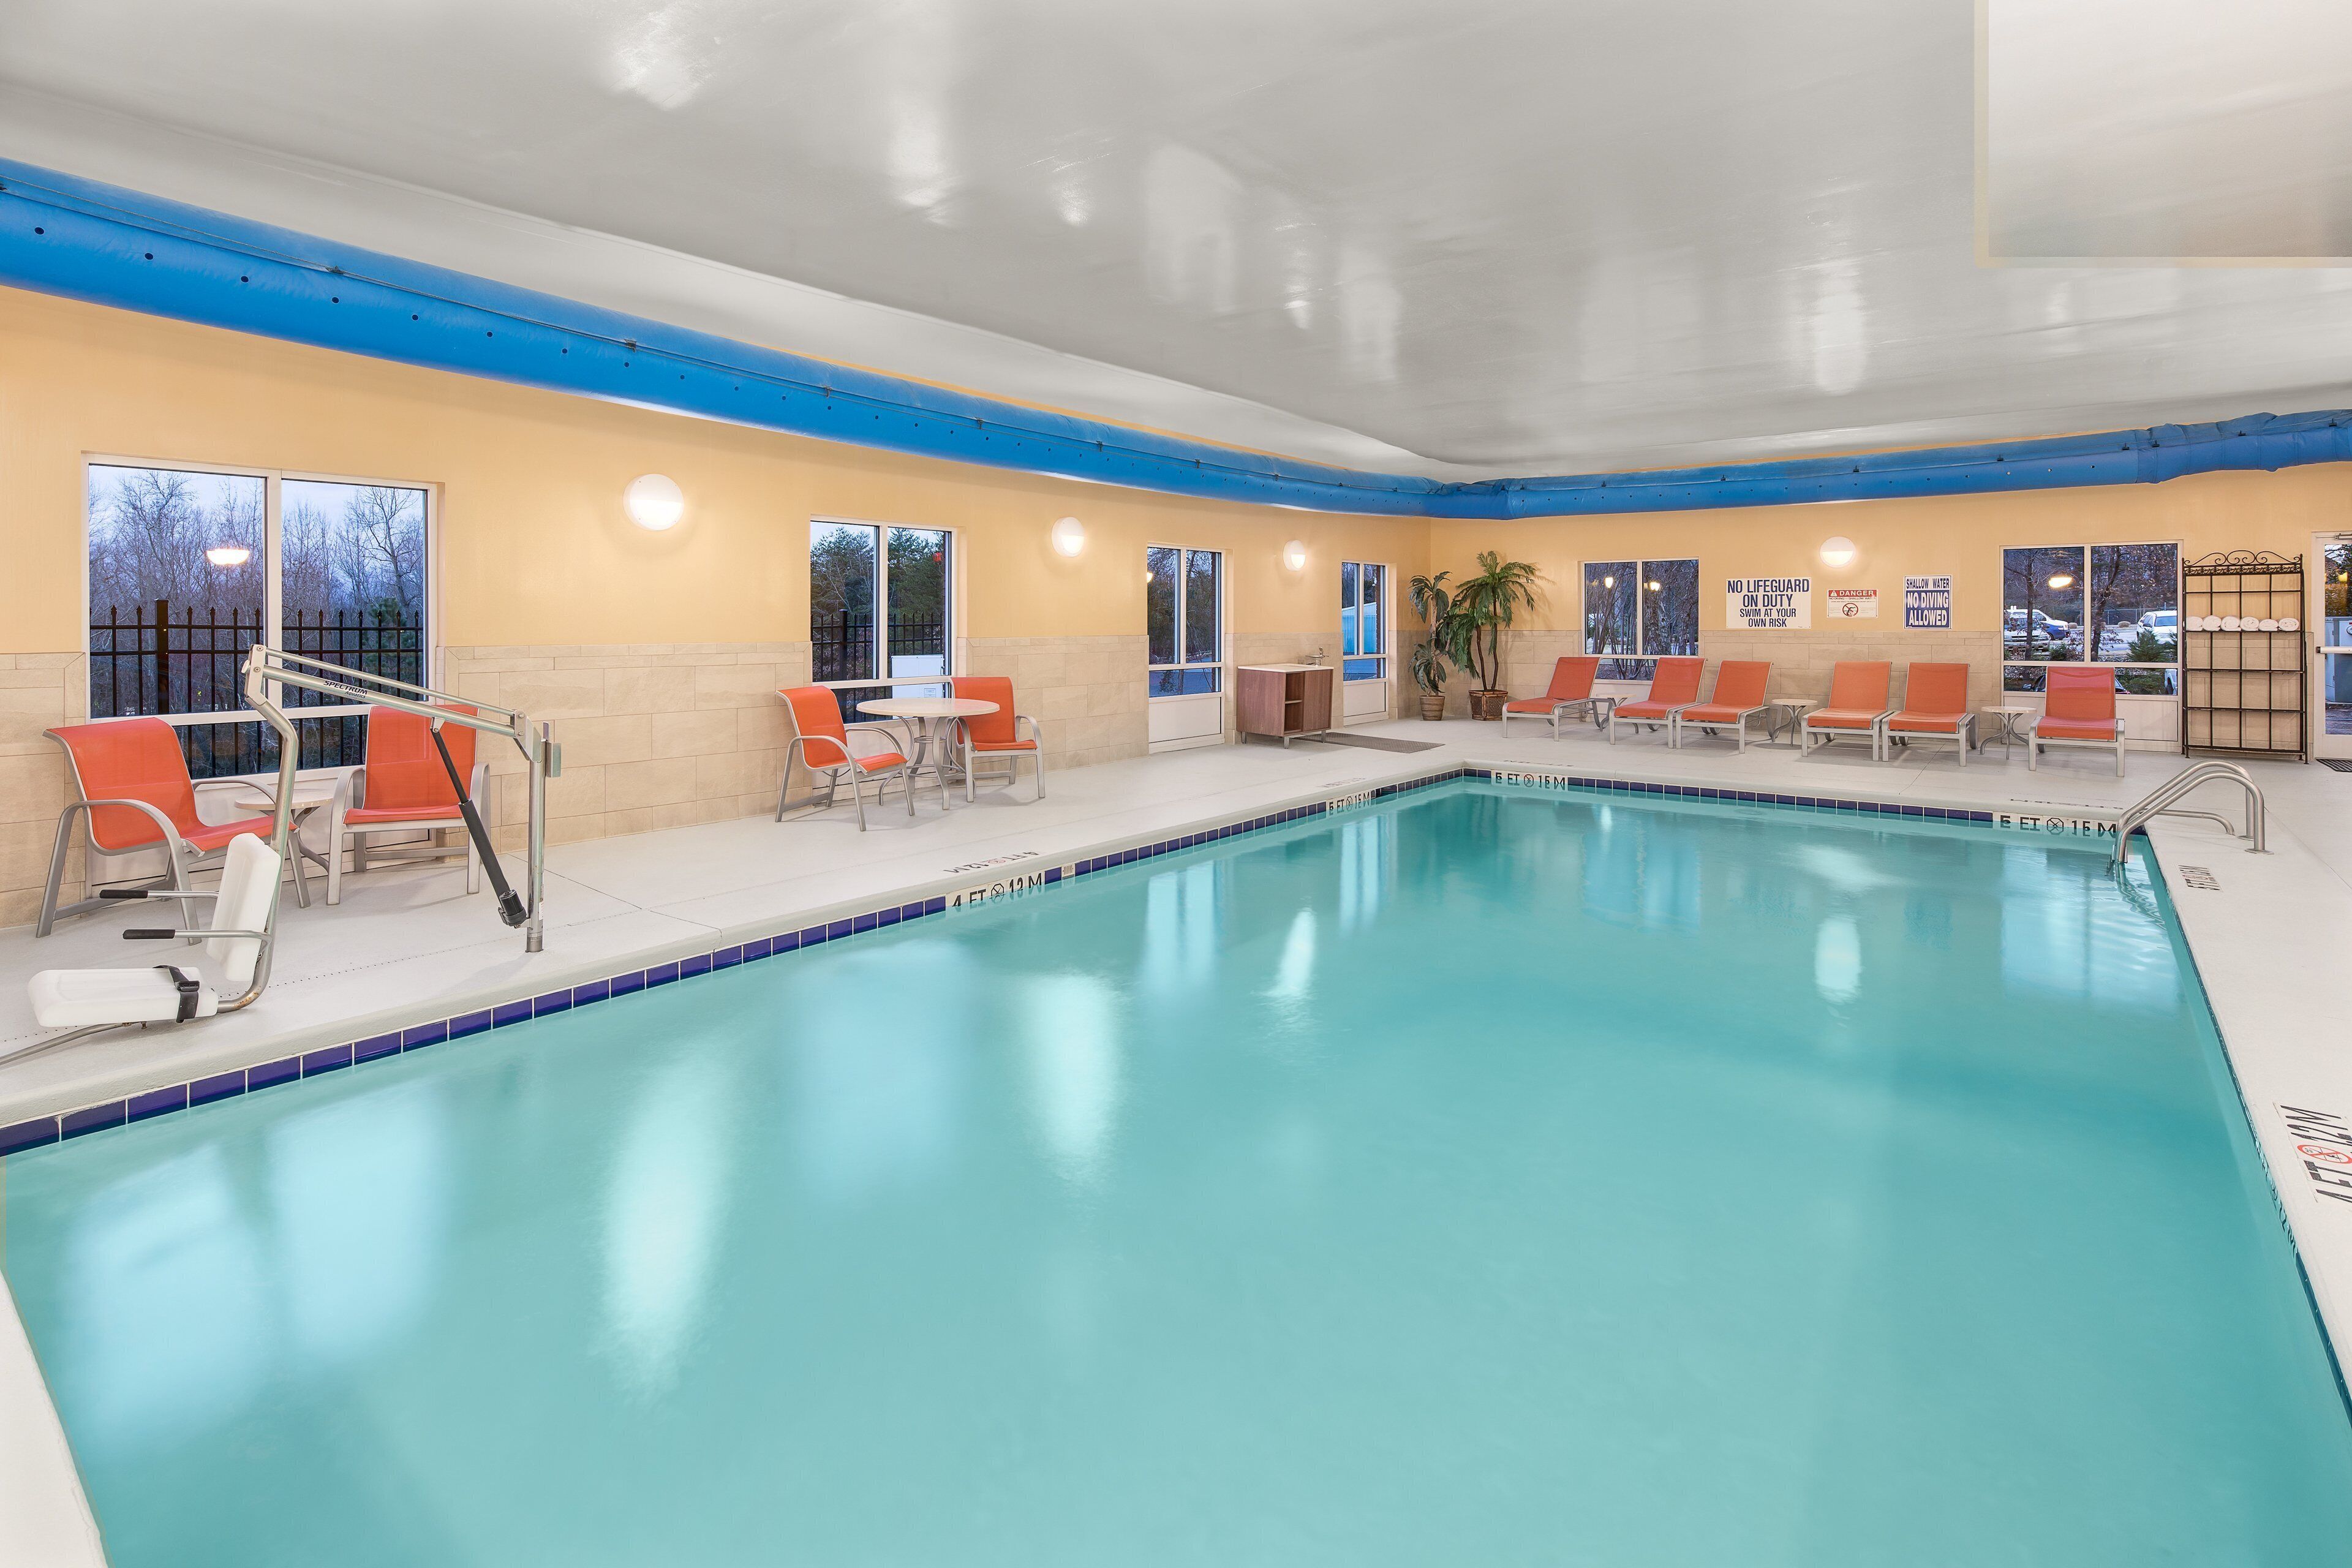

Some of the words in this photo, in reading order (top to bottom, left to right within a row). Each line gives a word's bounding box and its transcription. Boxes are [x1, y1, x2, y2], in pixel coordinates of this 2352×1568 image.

[1727, 580, 1743, 594] NO
[1747, 579, 1809, 593] LIFEGUARD
[1906, 578, 1929, 589] SHALLOW
[1932, 578, 1950, 589] WATER
[1743, 594, 1758, 607] ON
[1762, 594, 1793, 607] DUTY
[1907, 592, 1919, 608] NO
[1921, 592, 1949, 608] DIVING
[1740, 608, 1761, 617] SWIM
[1764, 608, 1773, 617] AT
[1776, 608, 1796, 617] YOUR
[1909, 609, 1947, 625] ALLOWED
[1748, 618, 1766, 627] OWN
[1769, 618, 1787, 627] RISK
[323, 680, 368, 695] SPECTRUM
[1495, 772, 1502, 780] 5
[1329, 801, 1334, 810] 5
[1336, 799, 1344, 808] FT
[2000, 815, 2011, 824] 5
[951, 894, 962, 907] 4
[970, 888, 987, 903] FT
[2304, 1159, 2352, 1188] FT
